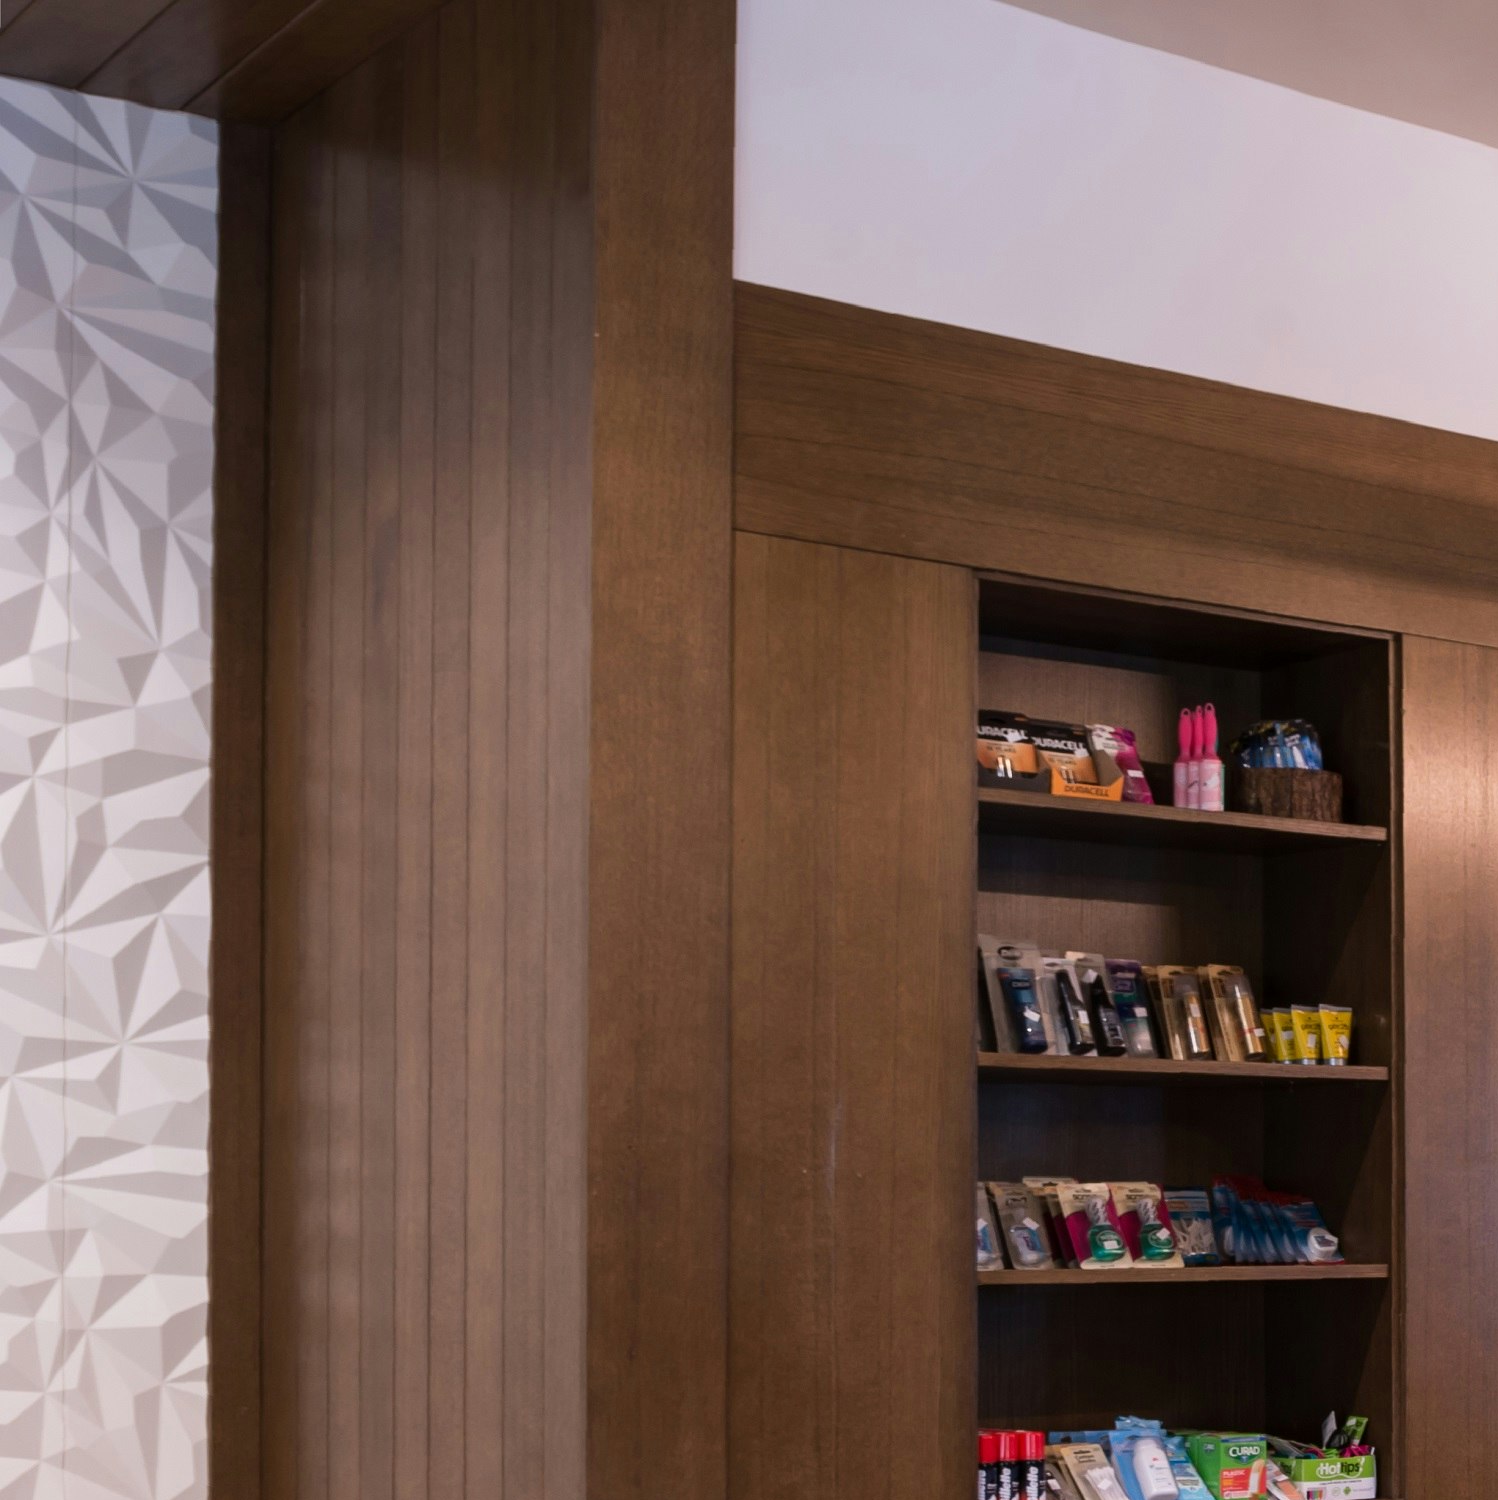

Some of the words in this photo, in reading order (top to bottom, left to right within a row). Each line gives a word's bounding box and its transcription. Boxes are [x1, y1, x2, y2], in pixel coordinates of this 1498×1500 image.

[977, 726, 1027, 741] URACELL
[1064, 785, 1110, 798] DURACELL
[1228, 1446, 1261, 1458] CURAD
